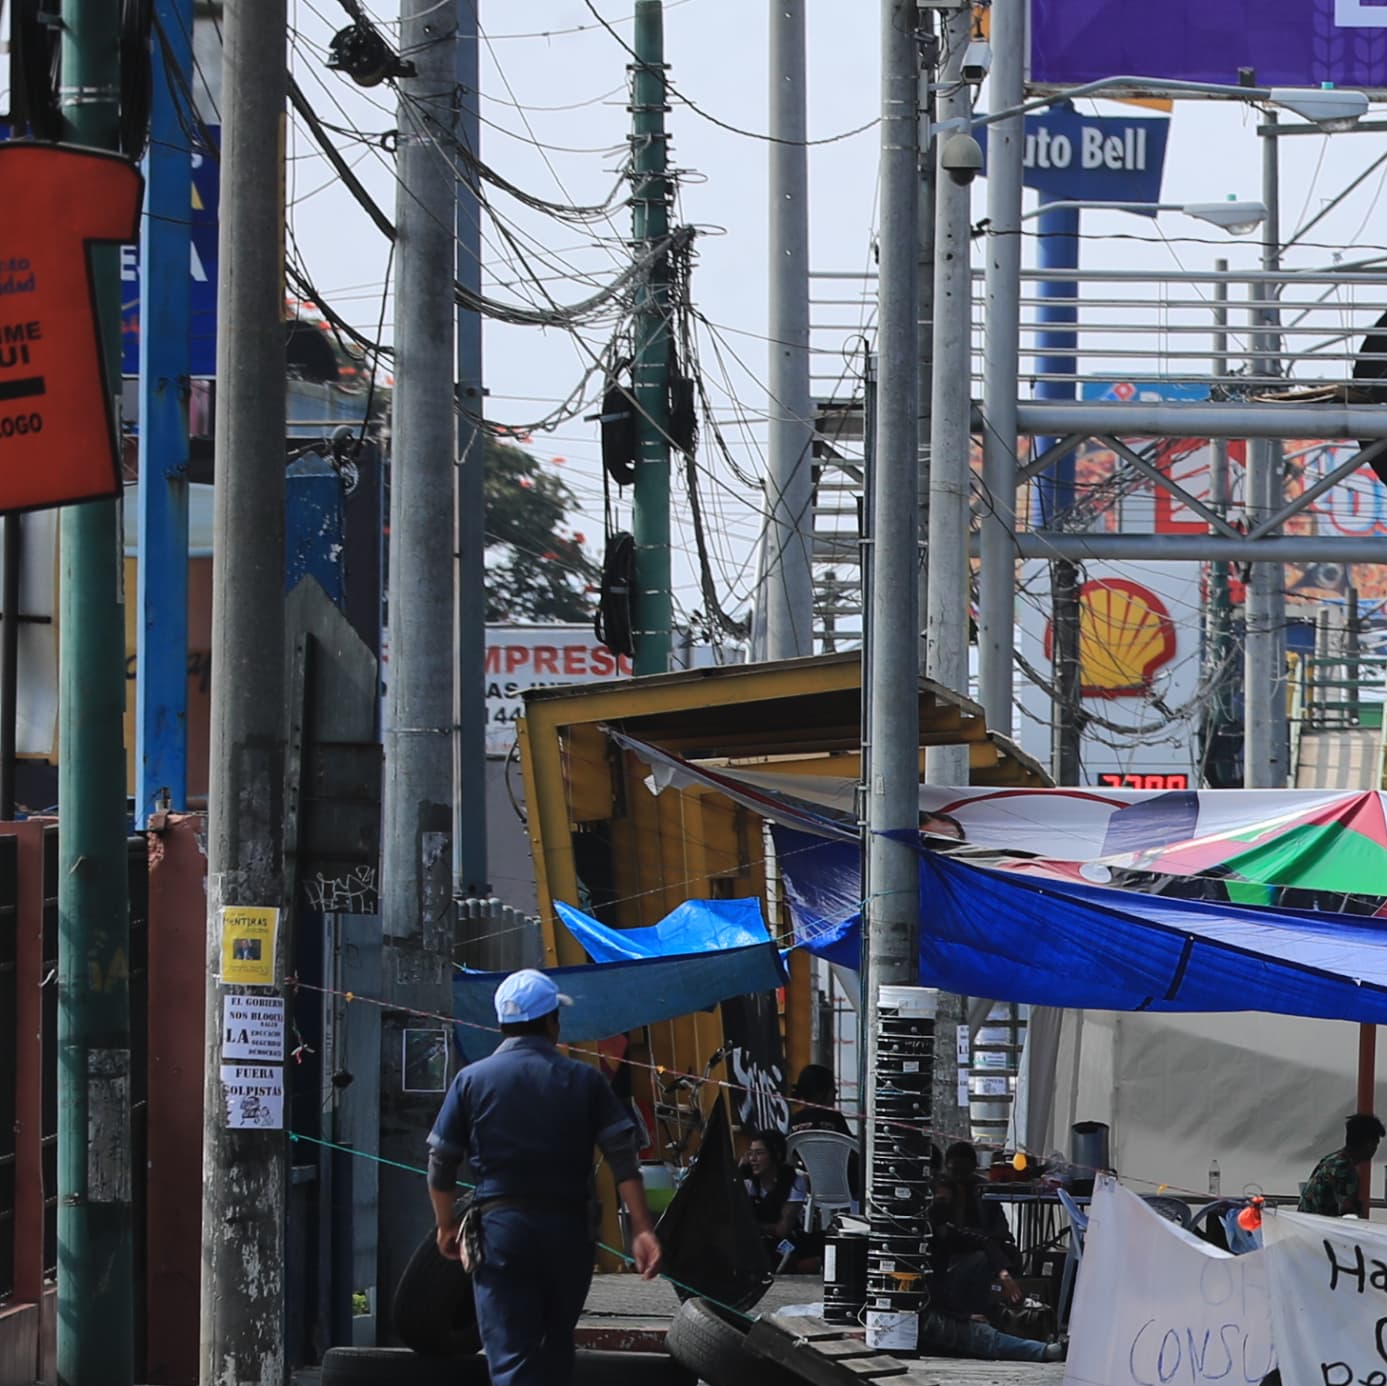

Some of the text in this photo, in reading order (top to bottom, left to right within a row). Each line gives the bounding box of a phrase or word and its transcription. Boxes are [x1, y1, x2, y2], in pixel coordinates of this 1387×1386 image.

[1081, 126, 1146, 170] Bell
[227, 1028, 249, 1044] LA
[236, 1067, 274, 1079] FUERA
